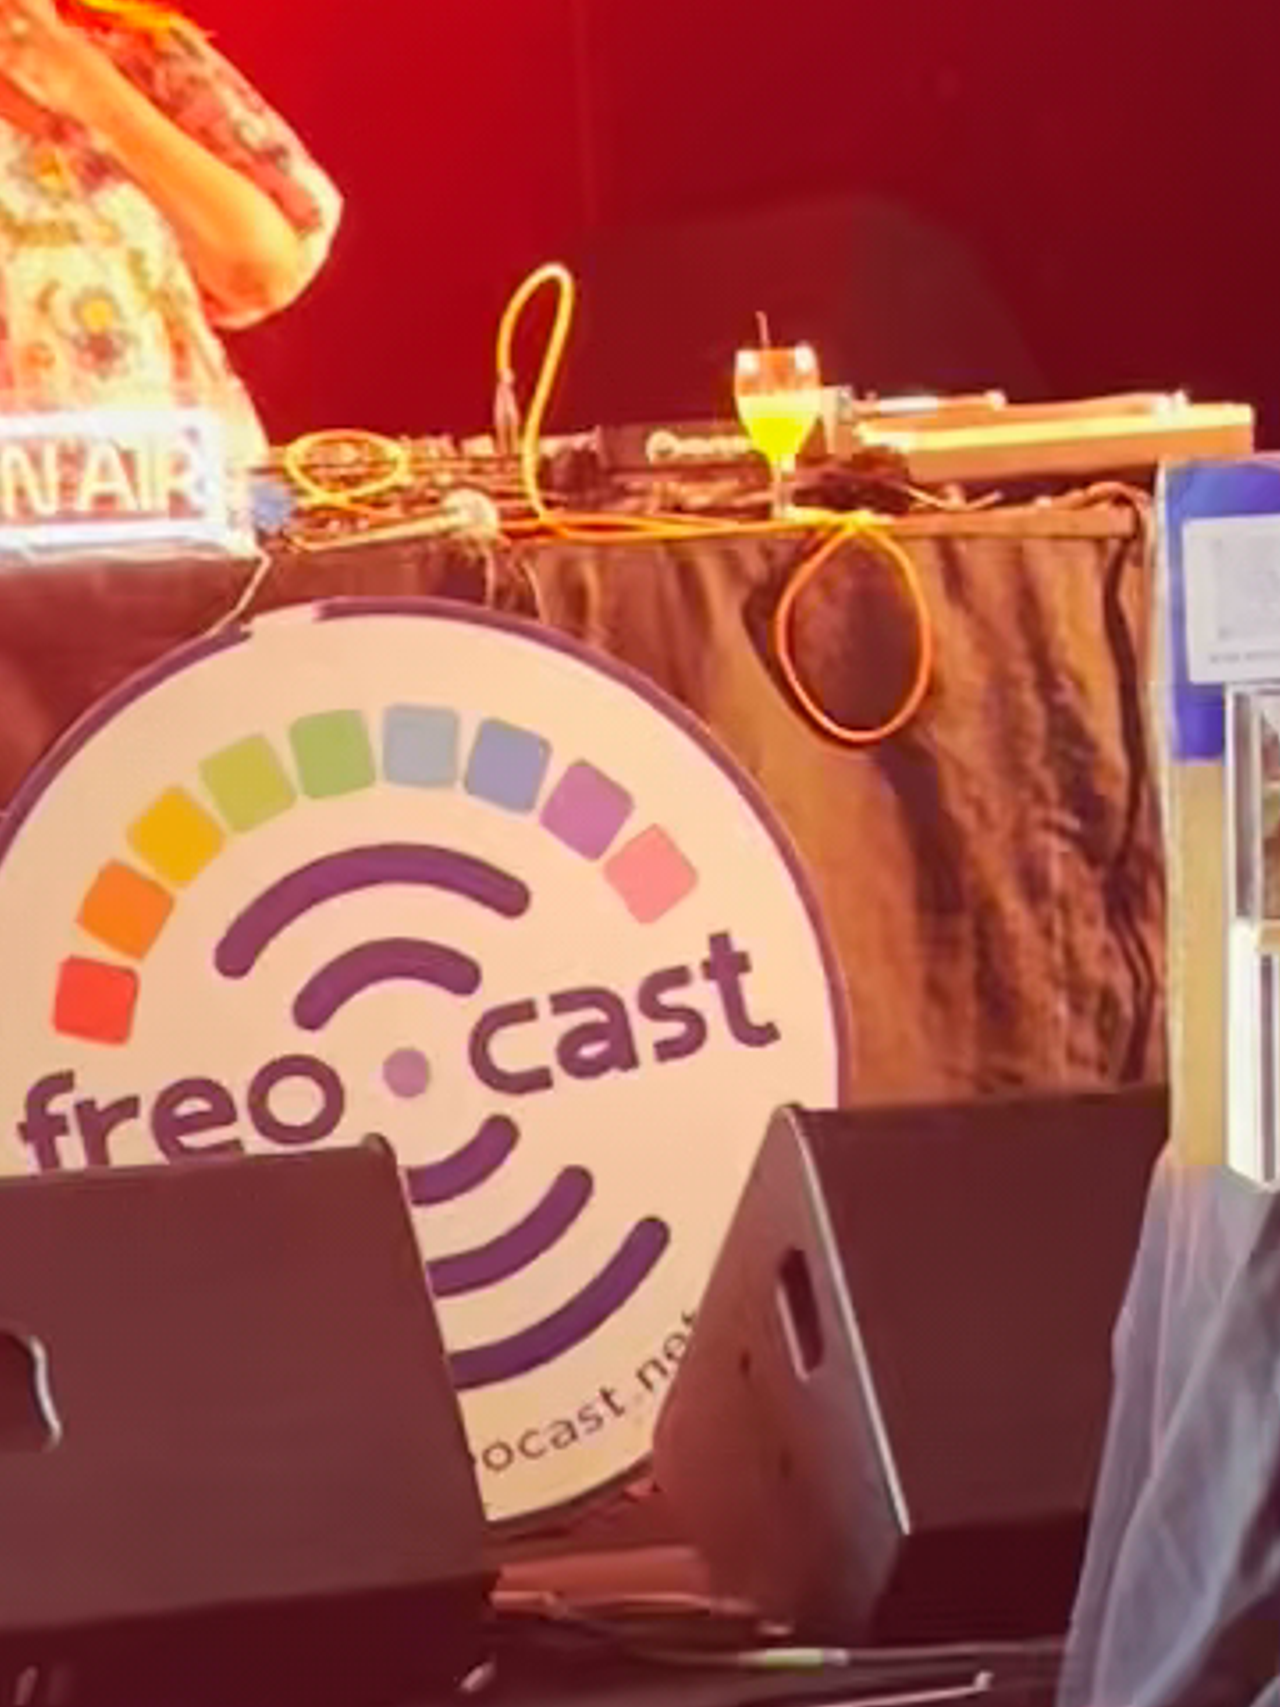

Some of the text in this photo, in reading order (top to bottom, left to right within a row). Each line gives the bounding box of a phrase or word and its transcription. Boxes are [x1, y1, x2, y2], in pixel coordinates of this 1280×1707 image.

[76, 438, 205, 516] AIR
[17, 931, 782, 1170] freo cast
